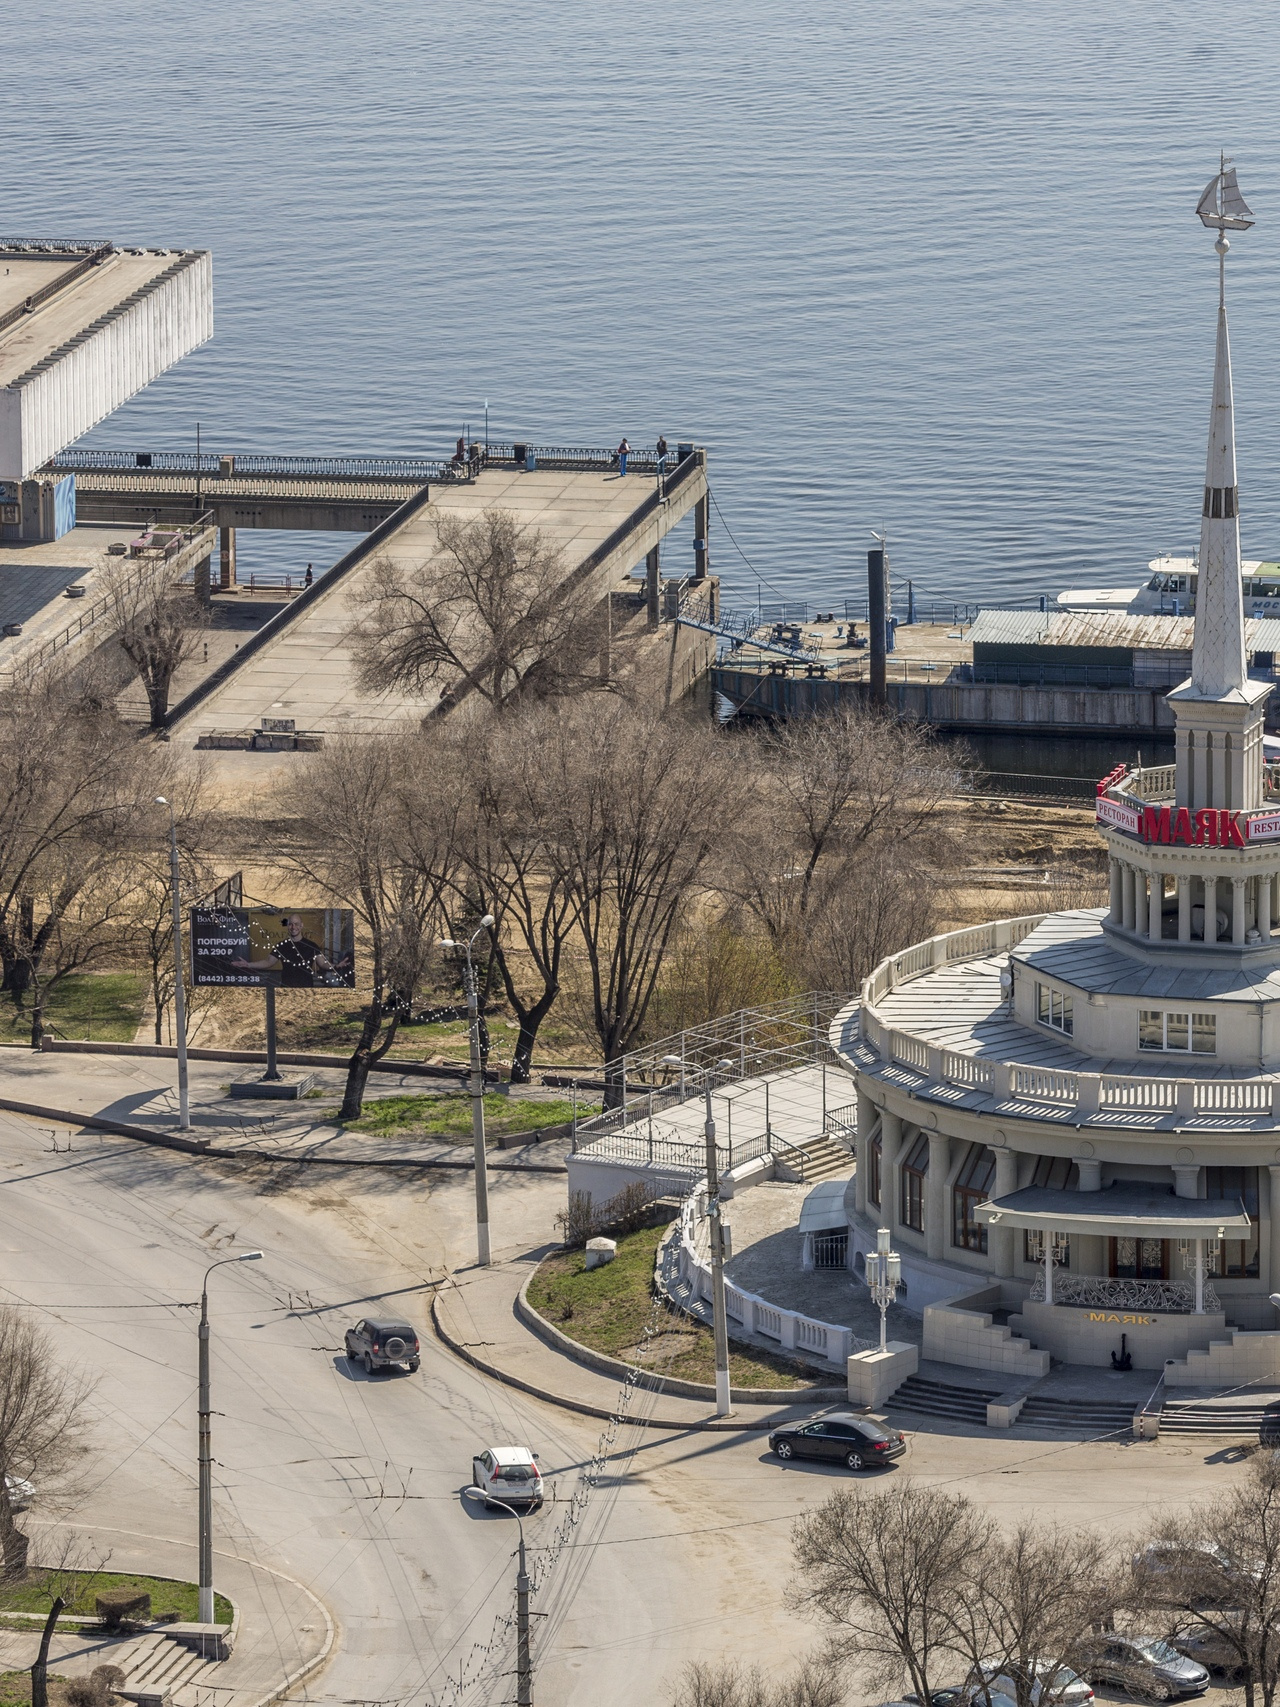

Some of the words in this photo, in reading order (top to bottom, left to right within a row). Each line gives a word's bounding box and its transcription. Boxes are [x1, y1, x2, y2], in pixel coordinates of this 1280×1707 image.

[1098, 803, 1136, 829] РЕСТОРАН
[1144, 805, 1246, 847] МАЯК
[197, 937, 248, 945] ПОПРОБУЙ!
[198, 975, 224, 983] (8442)
[1089, 1312, 1151, 1325] МАЯК
